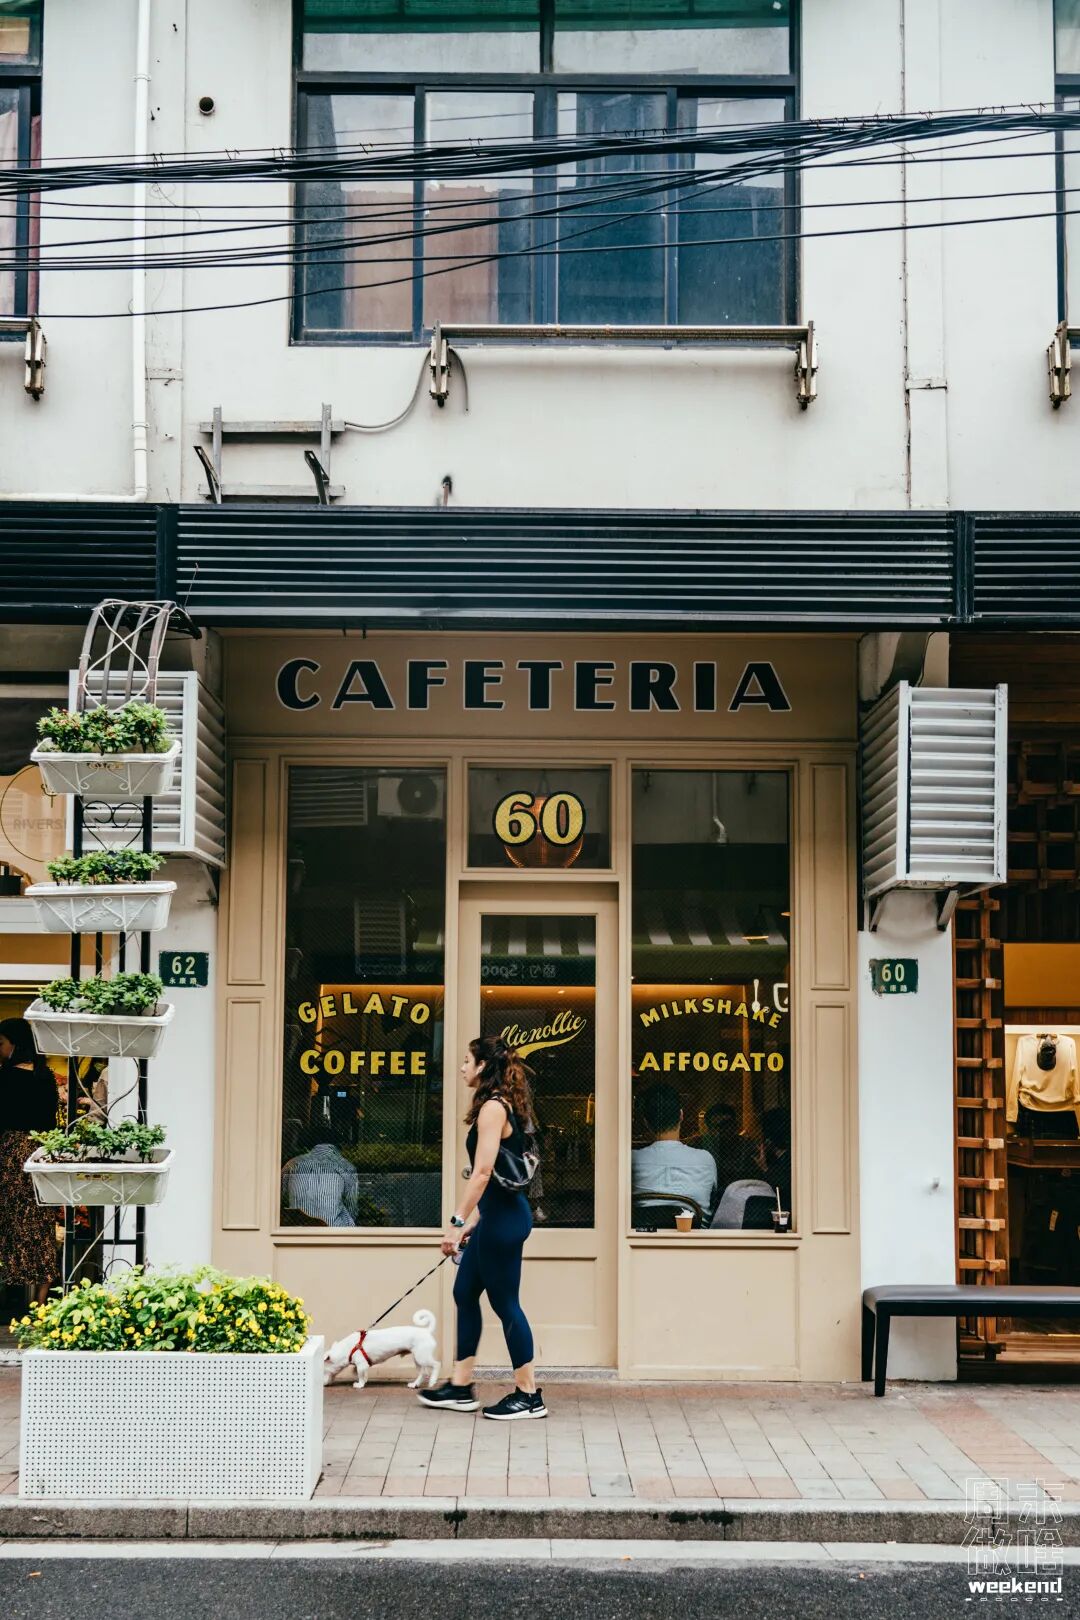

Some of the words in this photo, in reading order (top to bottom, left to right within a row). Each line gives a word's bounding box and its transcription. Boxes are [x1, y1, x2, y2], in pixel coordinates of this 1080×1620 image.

[276, 658, 791, 712] CAFETERIA
[13, 818, 66, 830] RIVERS
[493, 791, 586, 847] 60
[171, 955, 196, 975] 62
[881, 963, 905, 983] 60
[298, 992, 430, 1024] GELATO
[639, 997, 782, 1028] MILKSHAKE
[500, 1010, 586, 1048] llienollie
[299, 1049, 426, 1075] COFFEE
[638, 1051, 784, 1072] AFFOGATO
